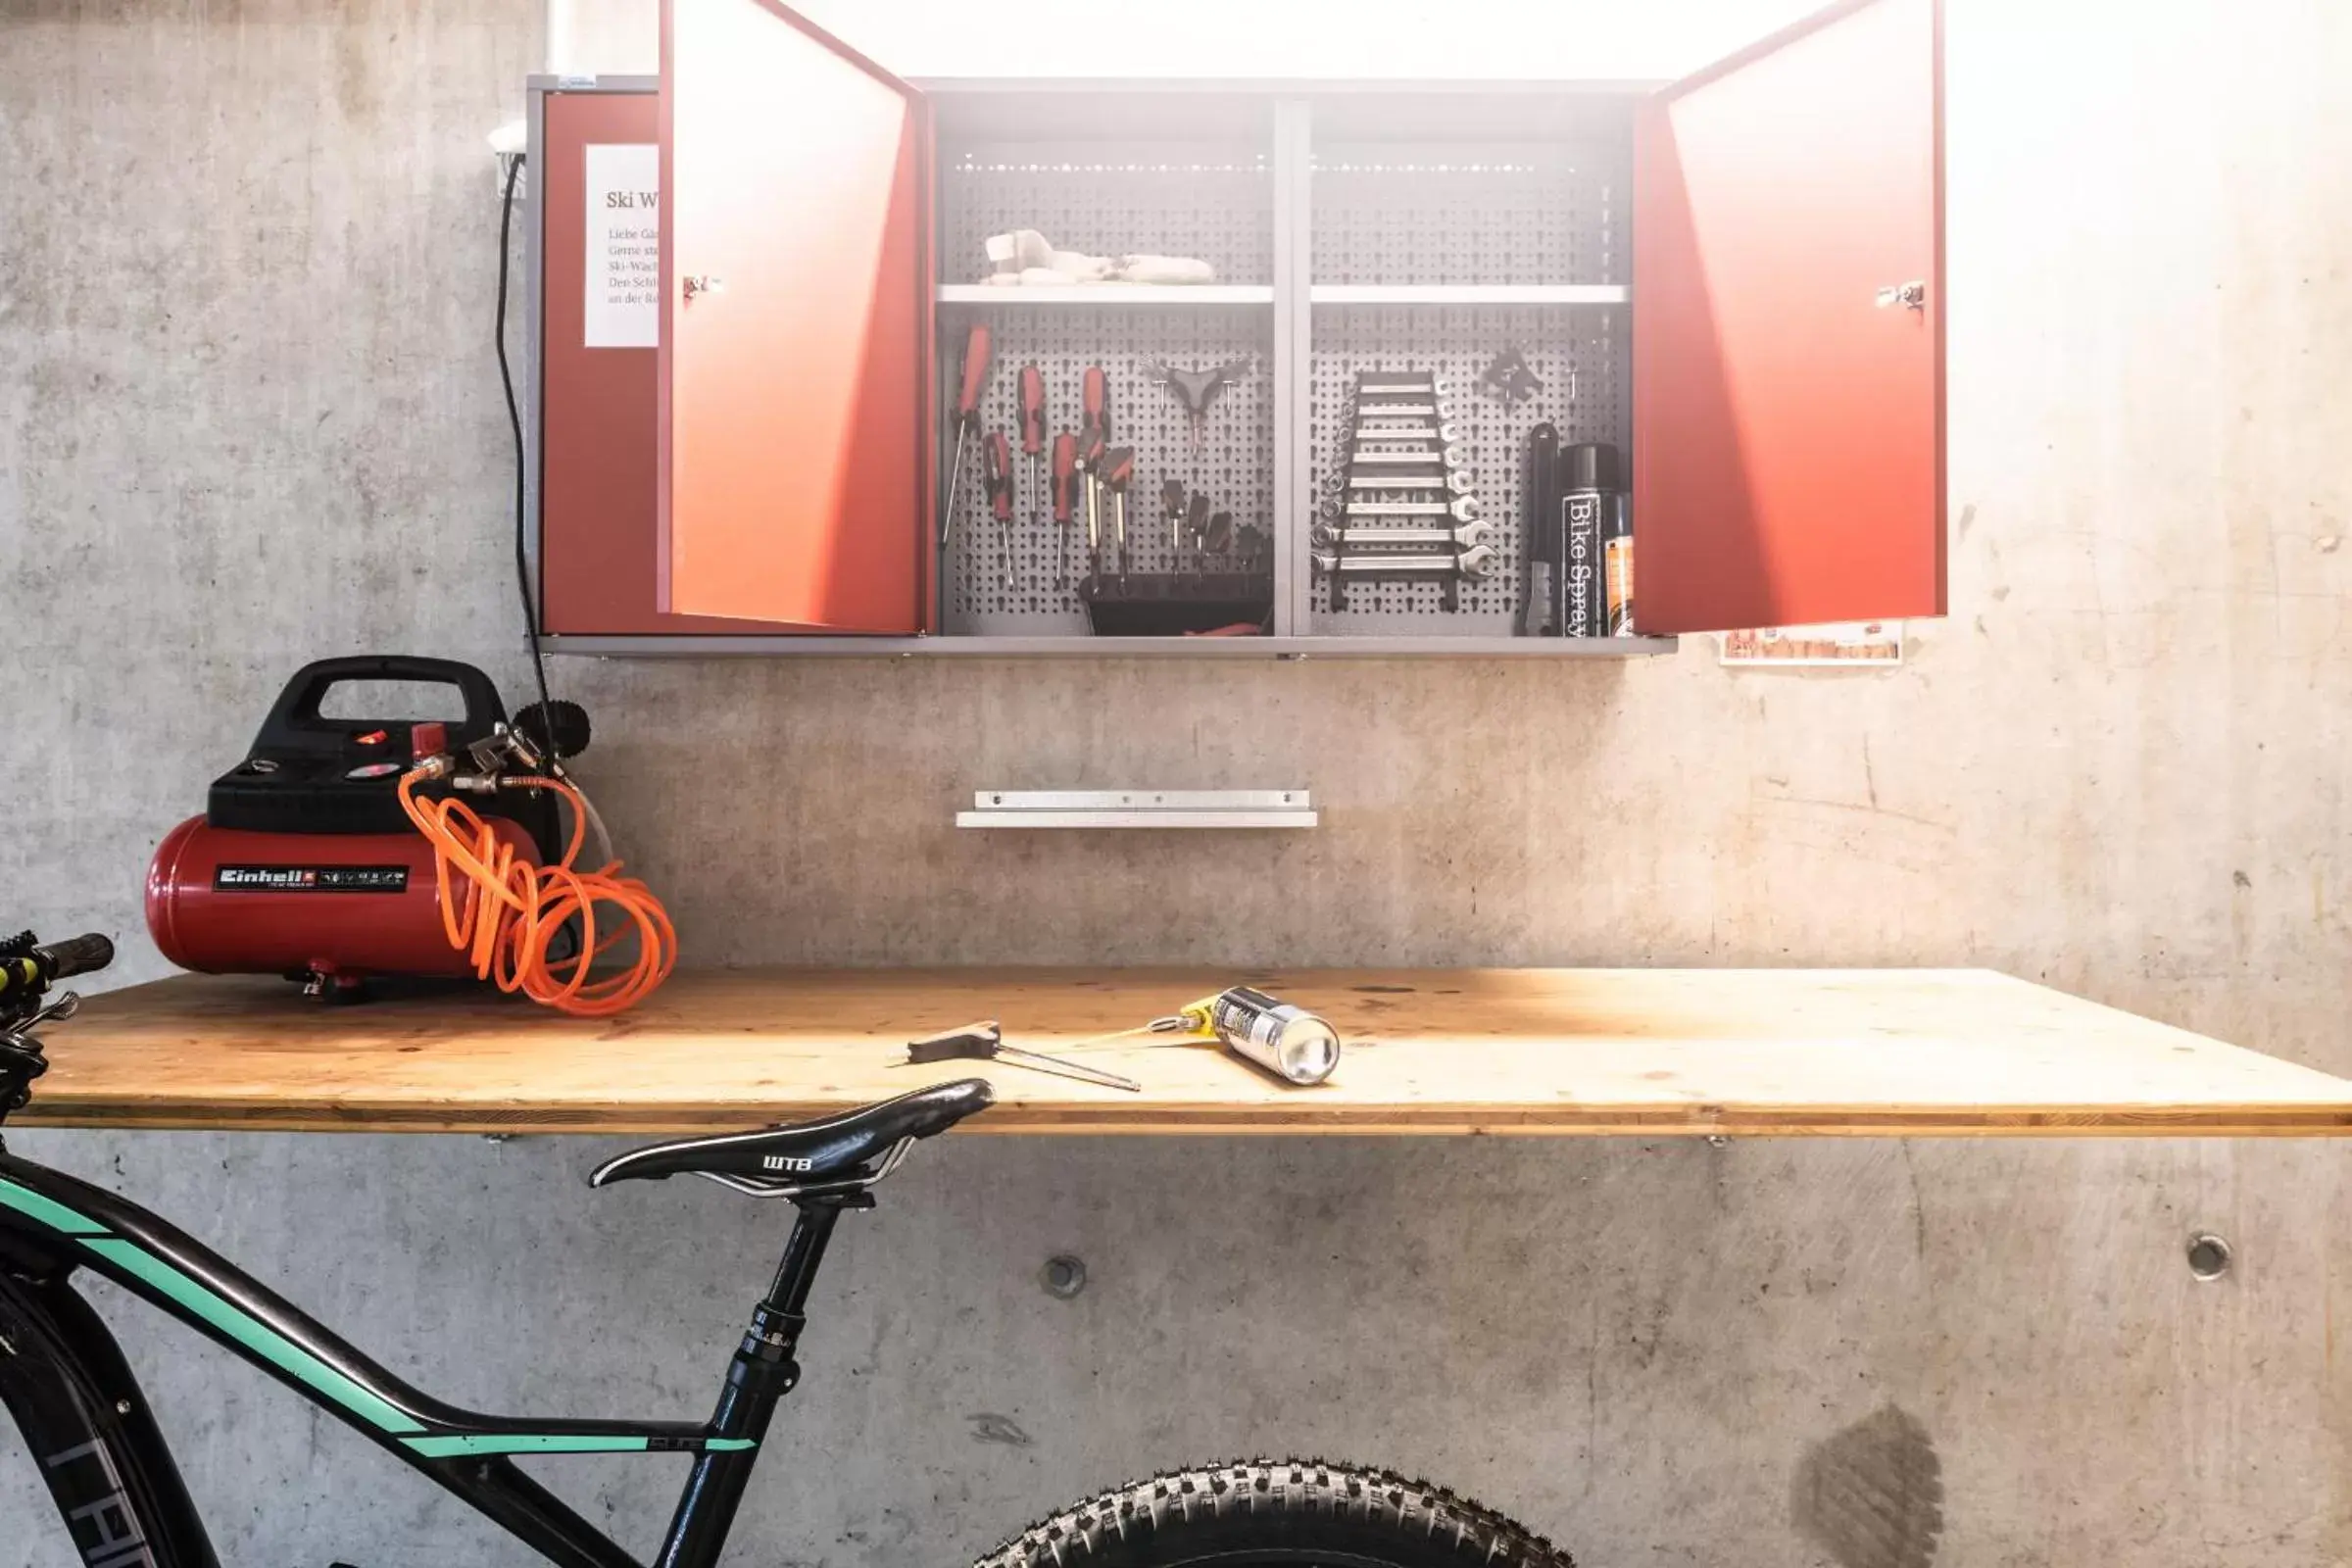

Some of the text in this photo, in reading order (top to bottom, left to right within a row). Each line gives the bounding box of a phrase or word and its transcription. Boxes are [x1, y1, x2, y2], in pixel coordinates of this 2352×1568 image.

[607, 191, 634, 208] Ski
[609, 227, 637, 239] Liebe
[1567, 501, 1592, 637] Bike Spray
[220, 869, 303, 882] Einhell
[761, 1154, 813, 1172] WTB
